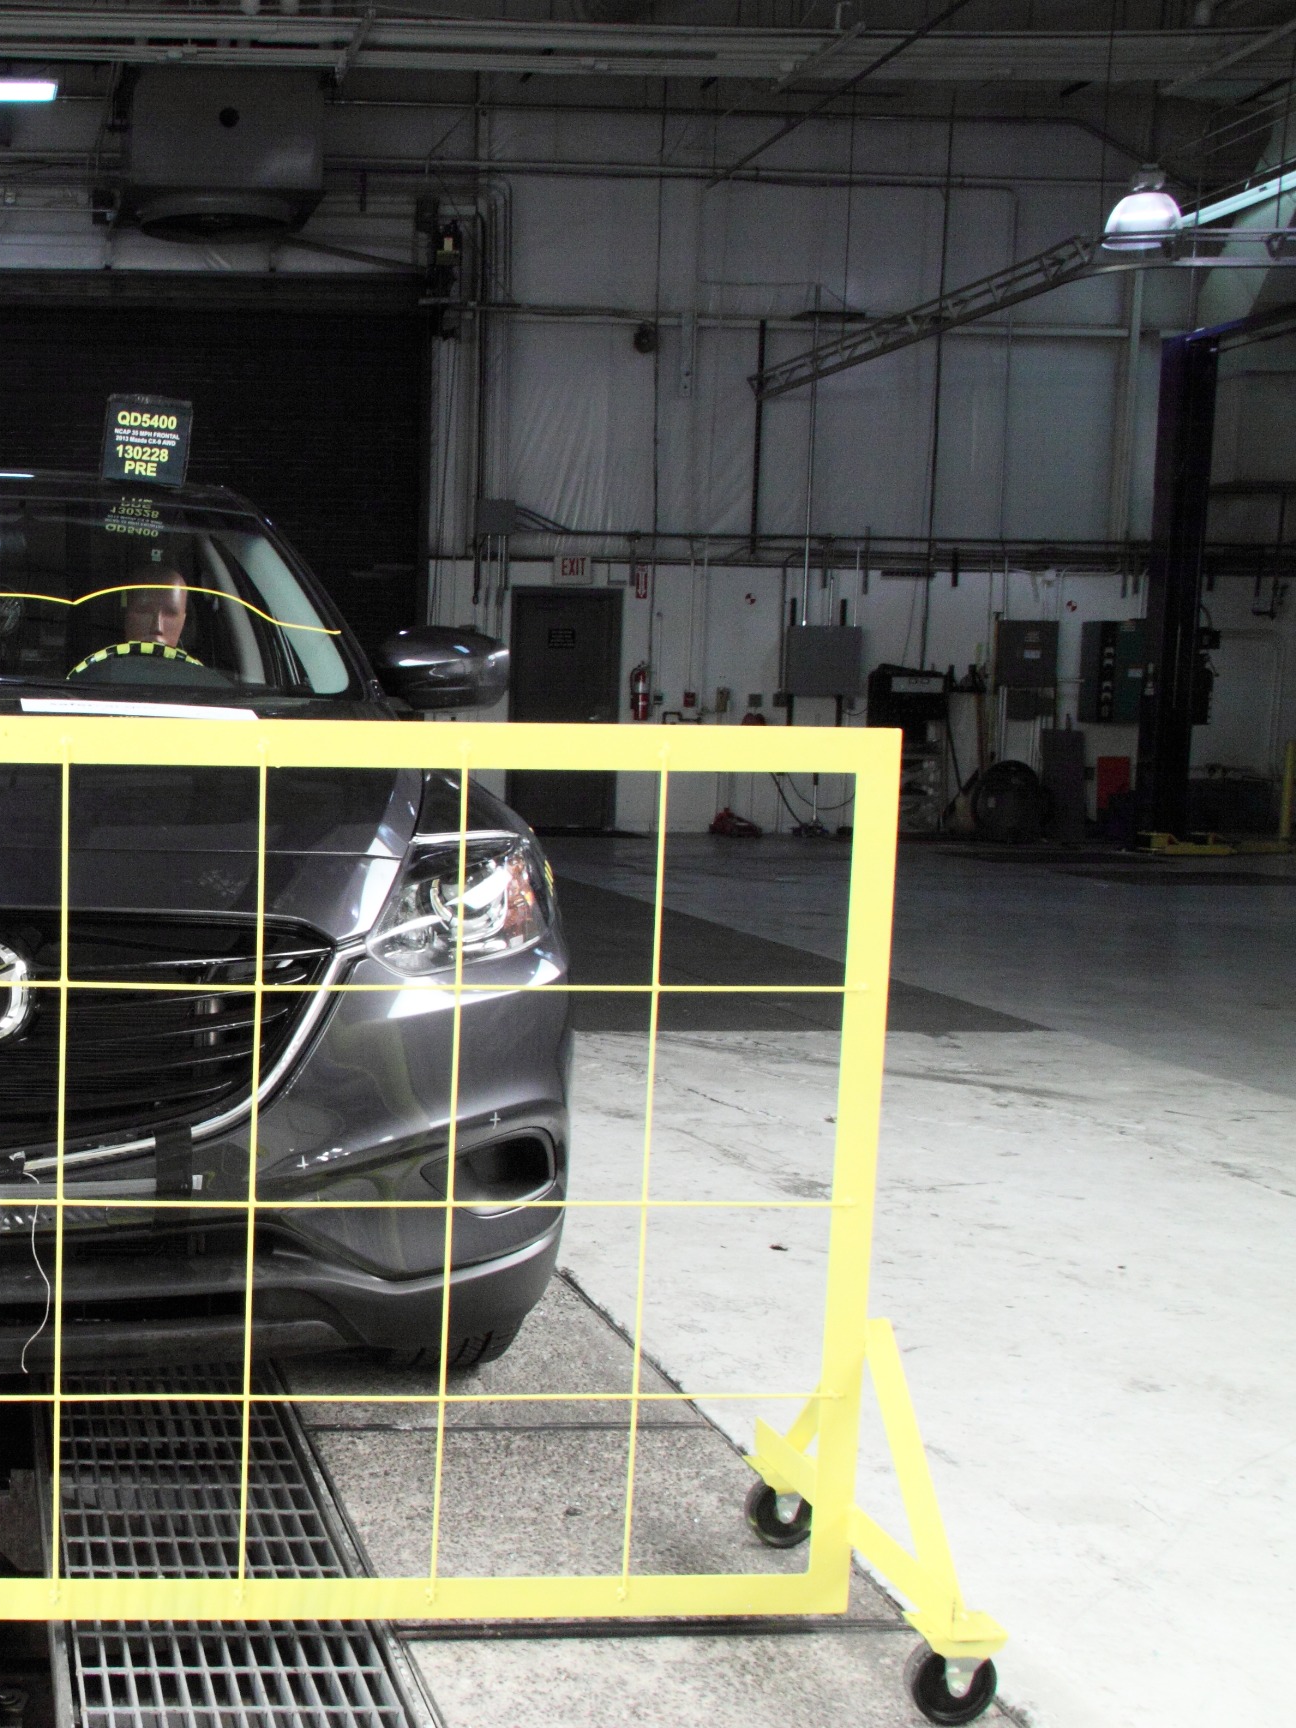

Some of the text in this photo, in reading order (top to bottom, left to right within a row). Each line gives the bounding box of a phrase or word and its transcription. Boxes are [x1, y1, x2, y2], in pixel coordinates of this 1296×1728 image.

[117, 411, 177, 430] QD5400
[114, 427, 131, 435] NCAP
[153, 431, 180, 440] FRONTAL
[116, 444, 168, 462] 130228
[124, 460, 157, 476] PRE
[561, 557, 586, 576] EXIT
